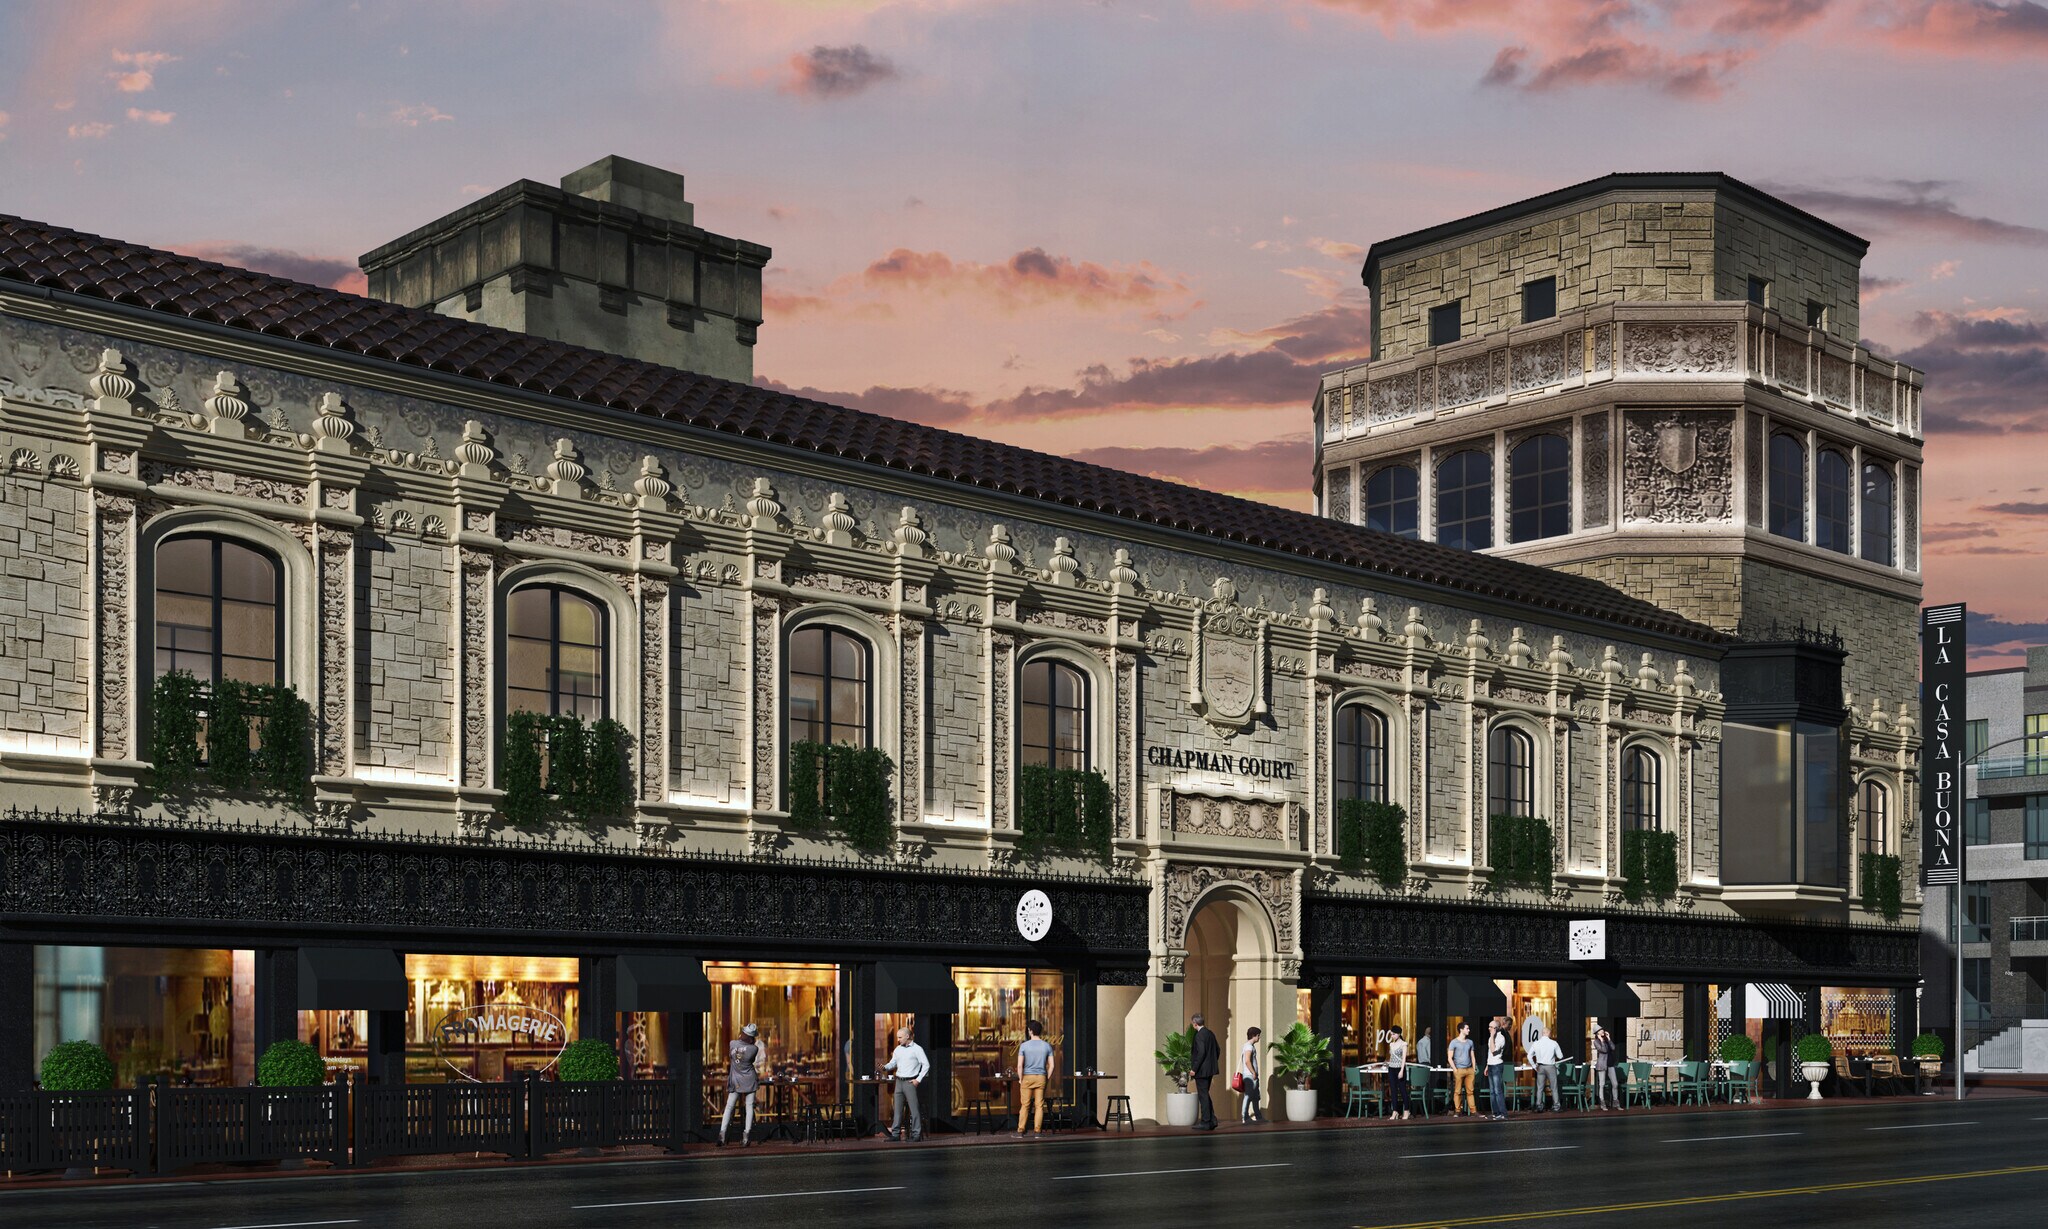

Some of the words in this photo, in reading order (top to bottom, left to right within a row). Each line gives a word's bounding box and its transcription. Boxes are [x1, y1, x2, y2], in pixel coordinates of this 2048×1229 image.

[1934, 626, 1952, 665] LA
[1934, 683, 1952, 760] CASA
[1147, 745, 1233, 773] CHAPMAN
[1239, 756, 1295, 780] COURT
[1934, 771, 1952, 866] BUONA
[440, 1014, 558, 1041] FROMAGERIE
[1528, 1022, 1539, 1043] la
